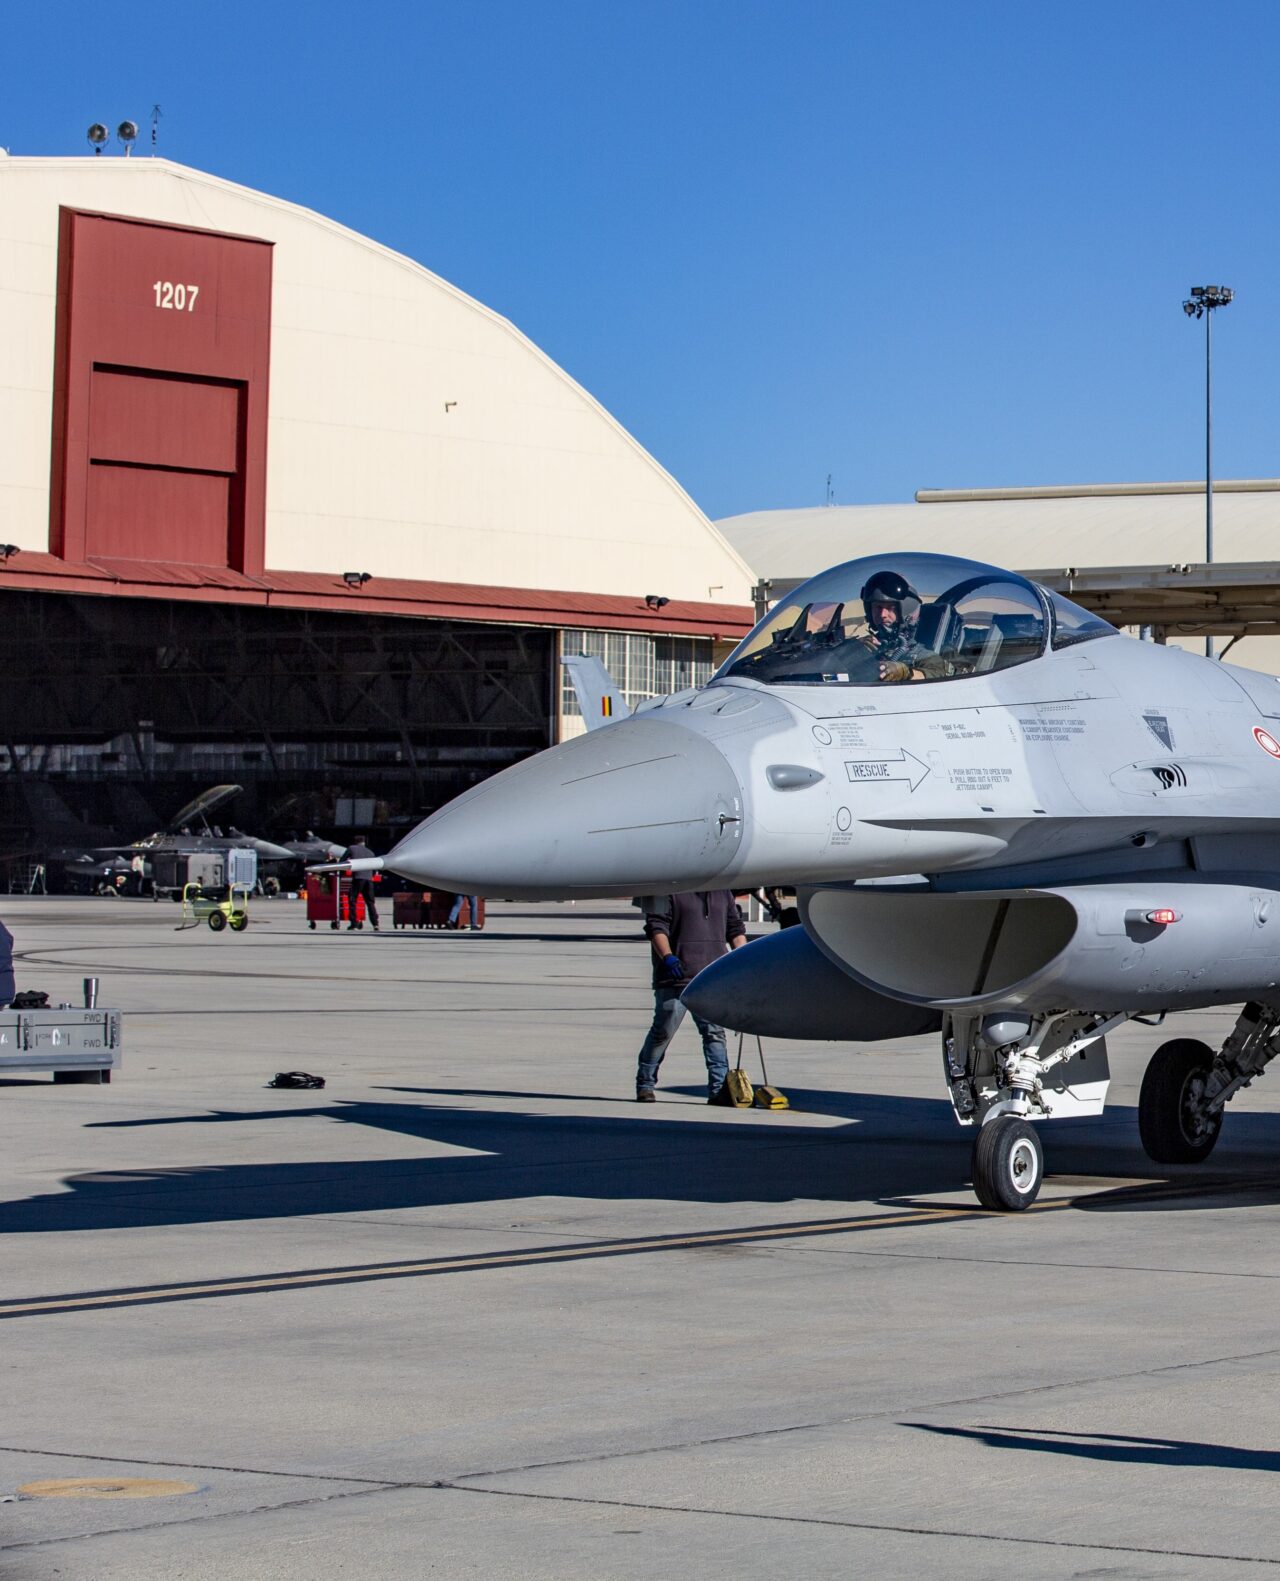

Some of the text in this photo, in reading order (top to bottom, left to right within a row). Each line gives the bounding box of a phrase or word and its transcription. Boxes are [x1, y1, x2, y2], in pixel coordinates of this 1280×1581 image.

[153, 280, 199, 312] 1207
[852, 763, 890, 778] RESCUE
[83, 1013, 102, 1023] FWD
[83, 1039, 101, 1049] FWD
